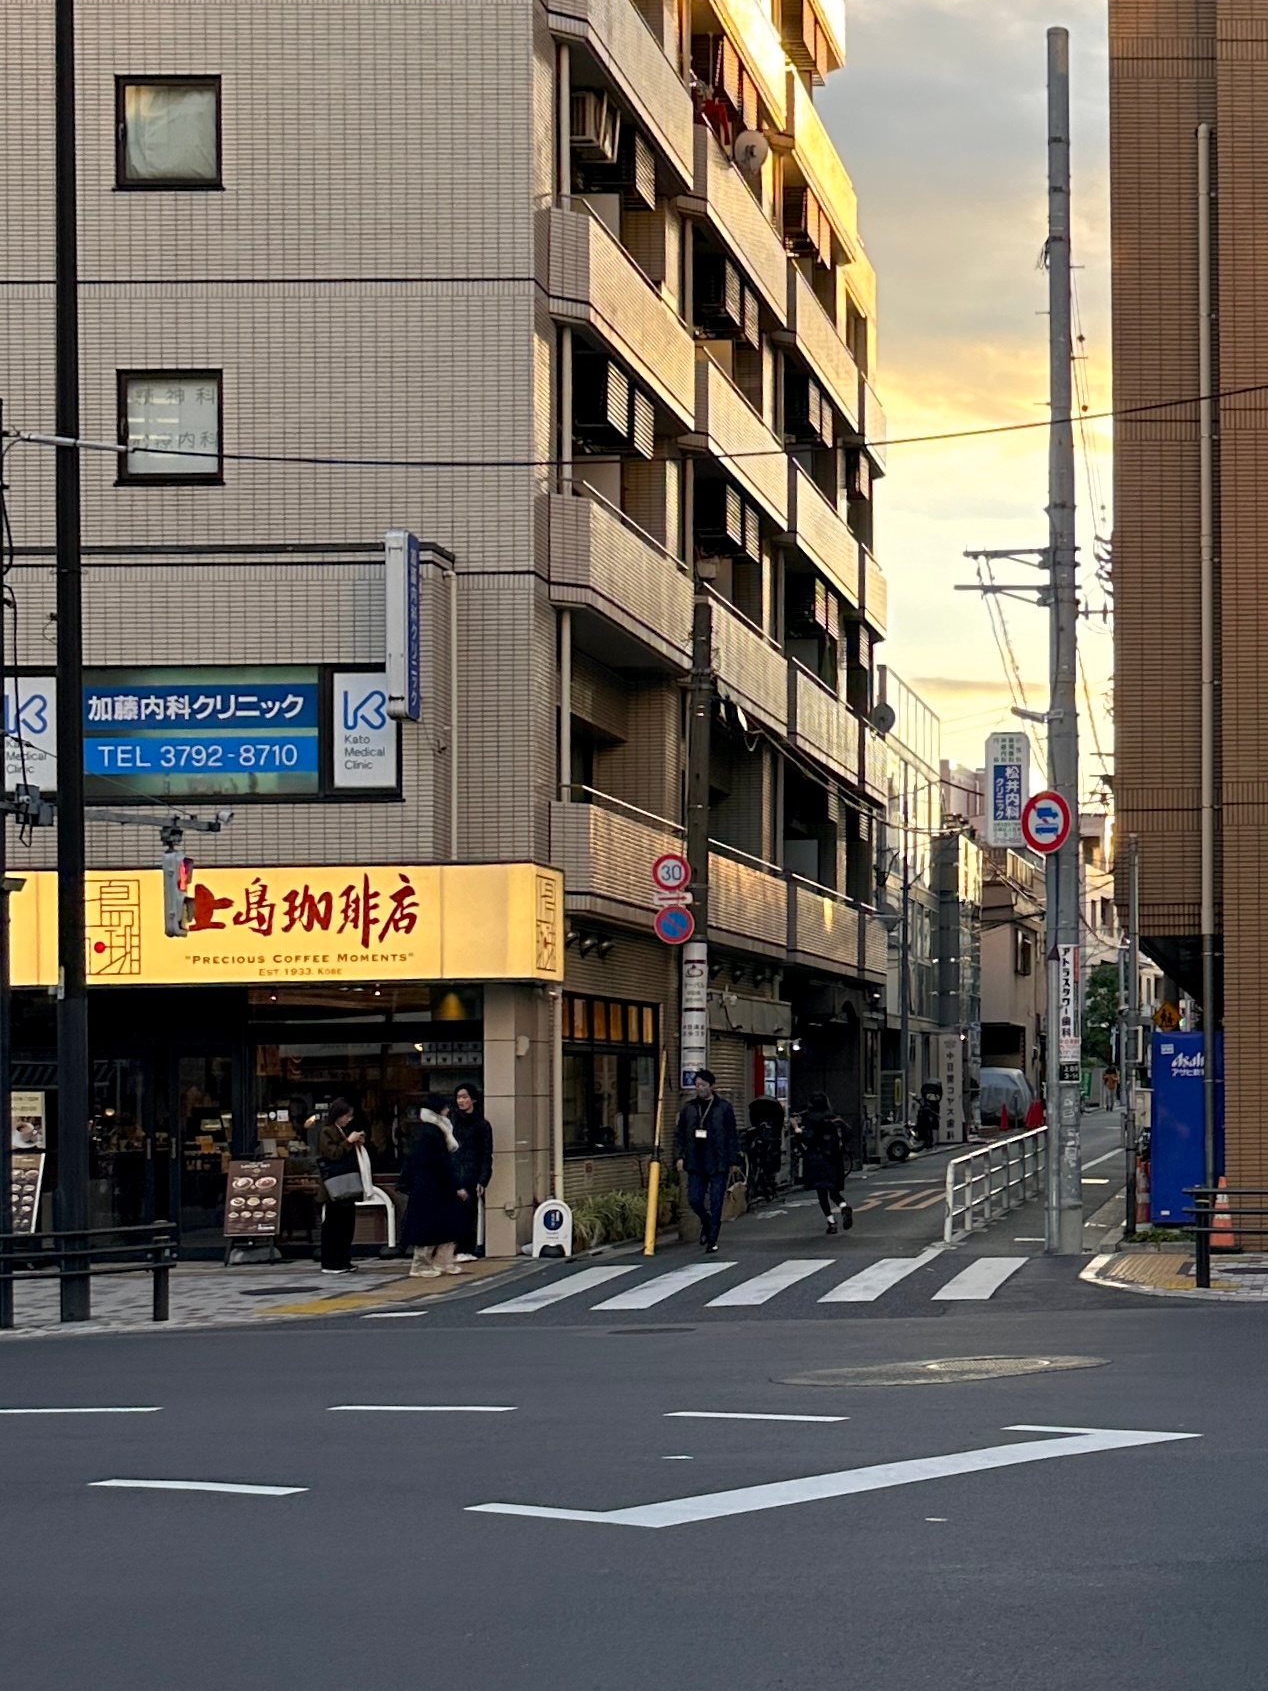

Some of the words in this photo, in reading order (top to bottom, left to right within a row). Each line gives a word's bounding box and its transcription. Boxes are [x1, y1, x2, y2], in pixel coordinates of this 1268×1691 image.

[88, 693, 304, 721] 加藤内科クリニック
[345, 734, 370, 744] Kato
[98, 746, 151, 767] TEL
[160, 744, 298, 767] 3792-8710
[345, 746, 385, 757] Medical
[345, 759, 373, 770] Clinic
[995, 777, 1004, 820] クリニック
[1005, 766, 1020, 819] 松井内科
[661, 864, 682, 881] 30
[188, 873, 420, 949] 上島珈琲店
[1171, 1052, 1205, 1067] Asah
[1171, 1068, 1205, 1077] アサヒ飲
